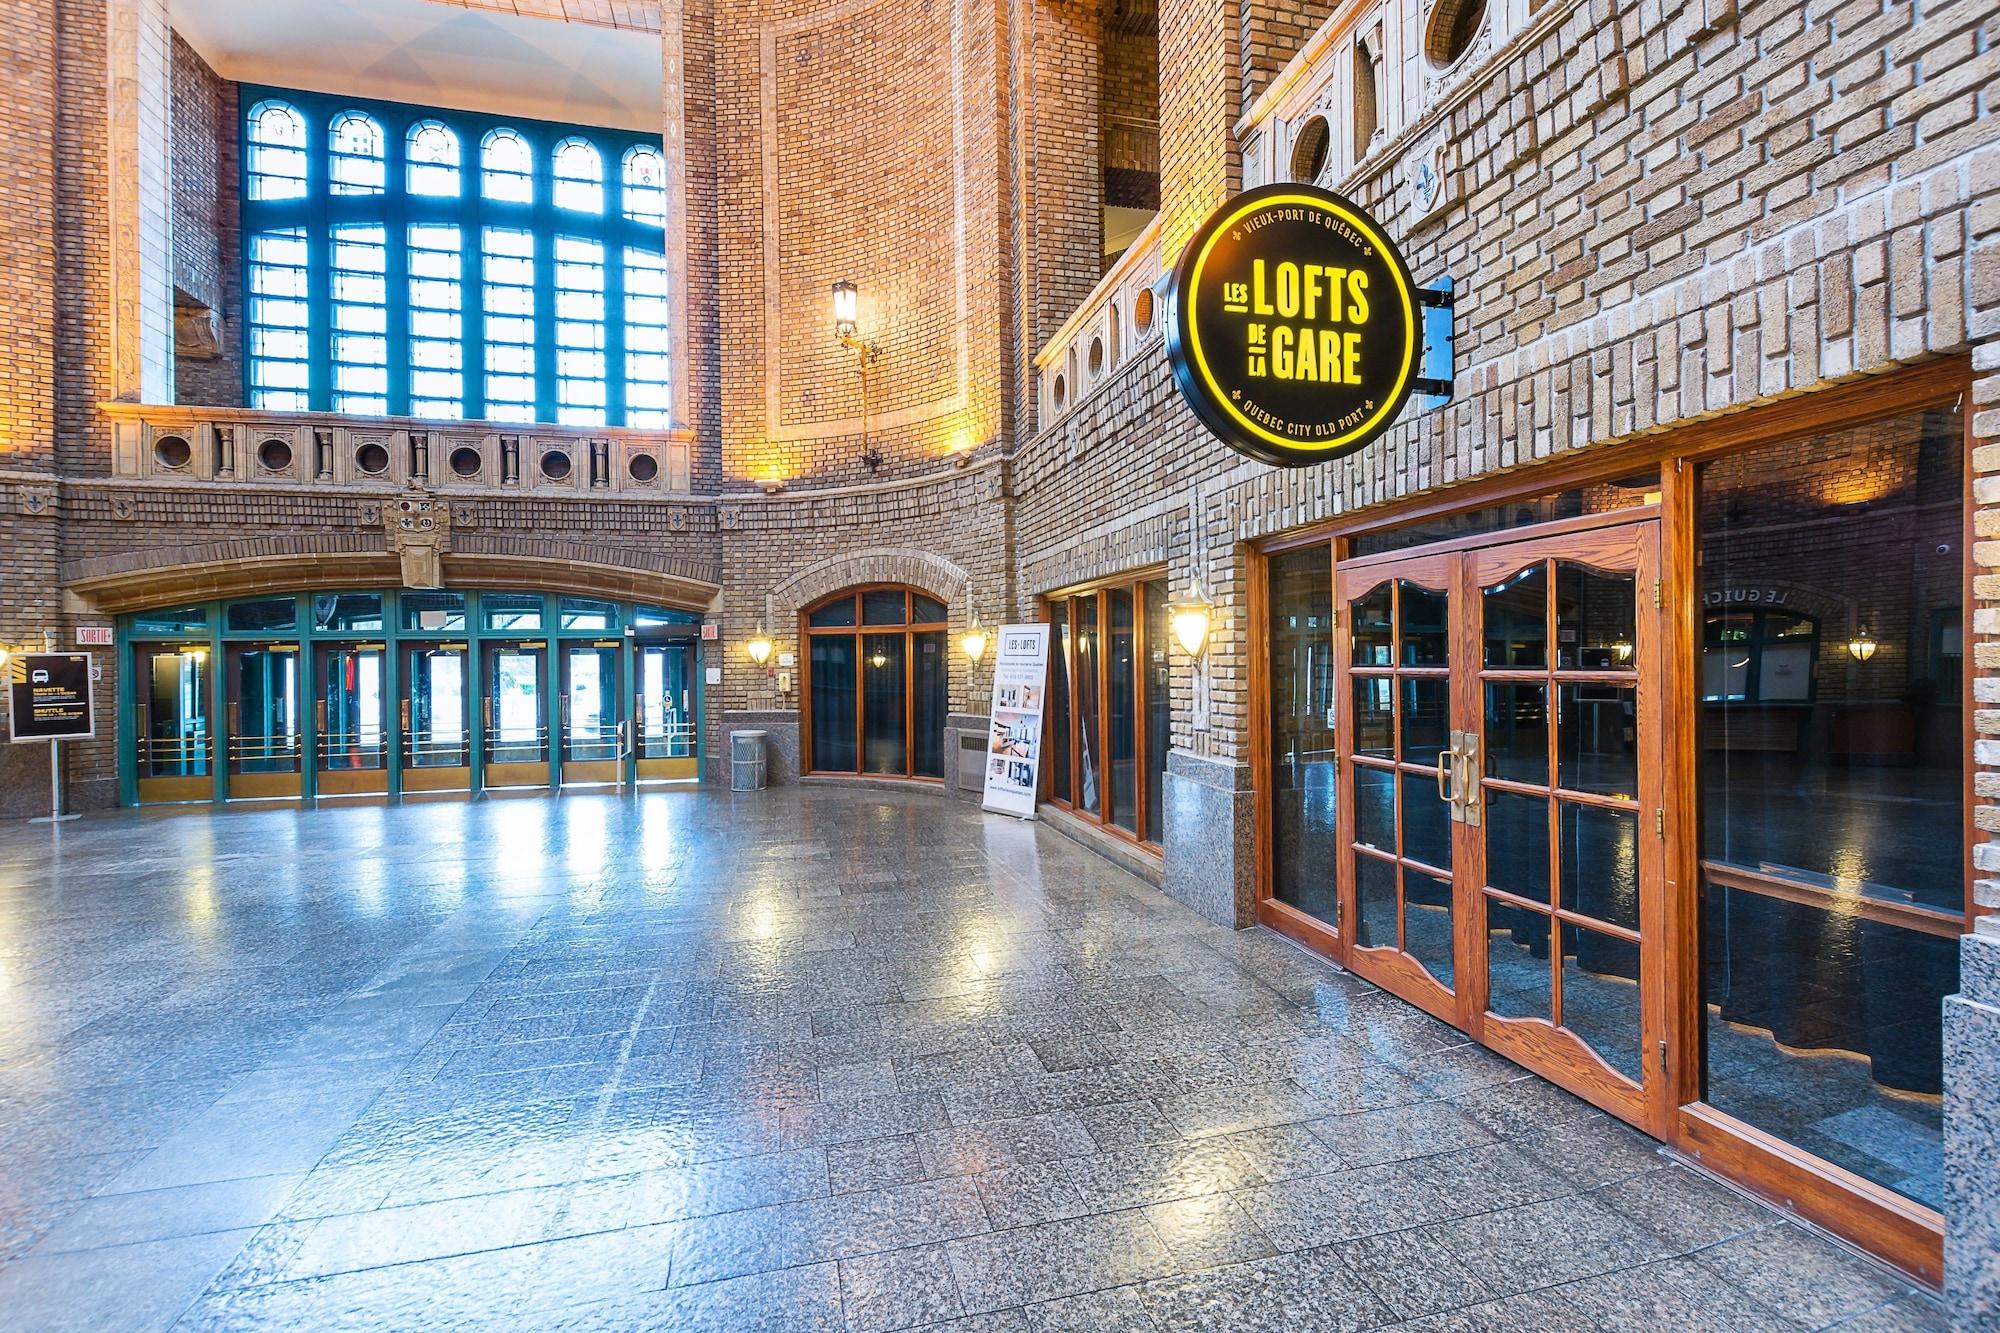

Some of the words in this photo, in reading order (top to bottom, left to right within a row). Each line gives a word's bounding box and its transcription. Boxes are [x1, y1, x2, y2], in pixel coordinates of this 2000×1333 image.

[1243, 209, 1305, 234] VIEUX-PORT
[1308, 211, 1322, 225] DE
[1324, 216, 1363, 247] QUÉBEC
[1224, 282, 1249, 304] LES
[1253, 259, 1369, 325] LOFTS
[1248, 323, 1266, 344] DE
[1248, 356, 1267, 377] LA
[1271, 325, 1362, 385] GARE
[1243, 400, 1284, 431] QUEBEC
[1287, 422, 1311, 437] CITY
[1315, 422, 1336, 436] OLD
[1338, 408, 1364, 430] PORT
[81, 629, 109, 643] SORTIE
